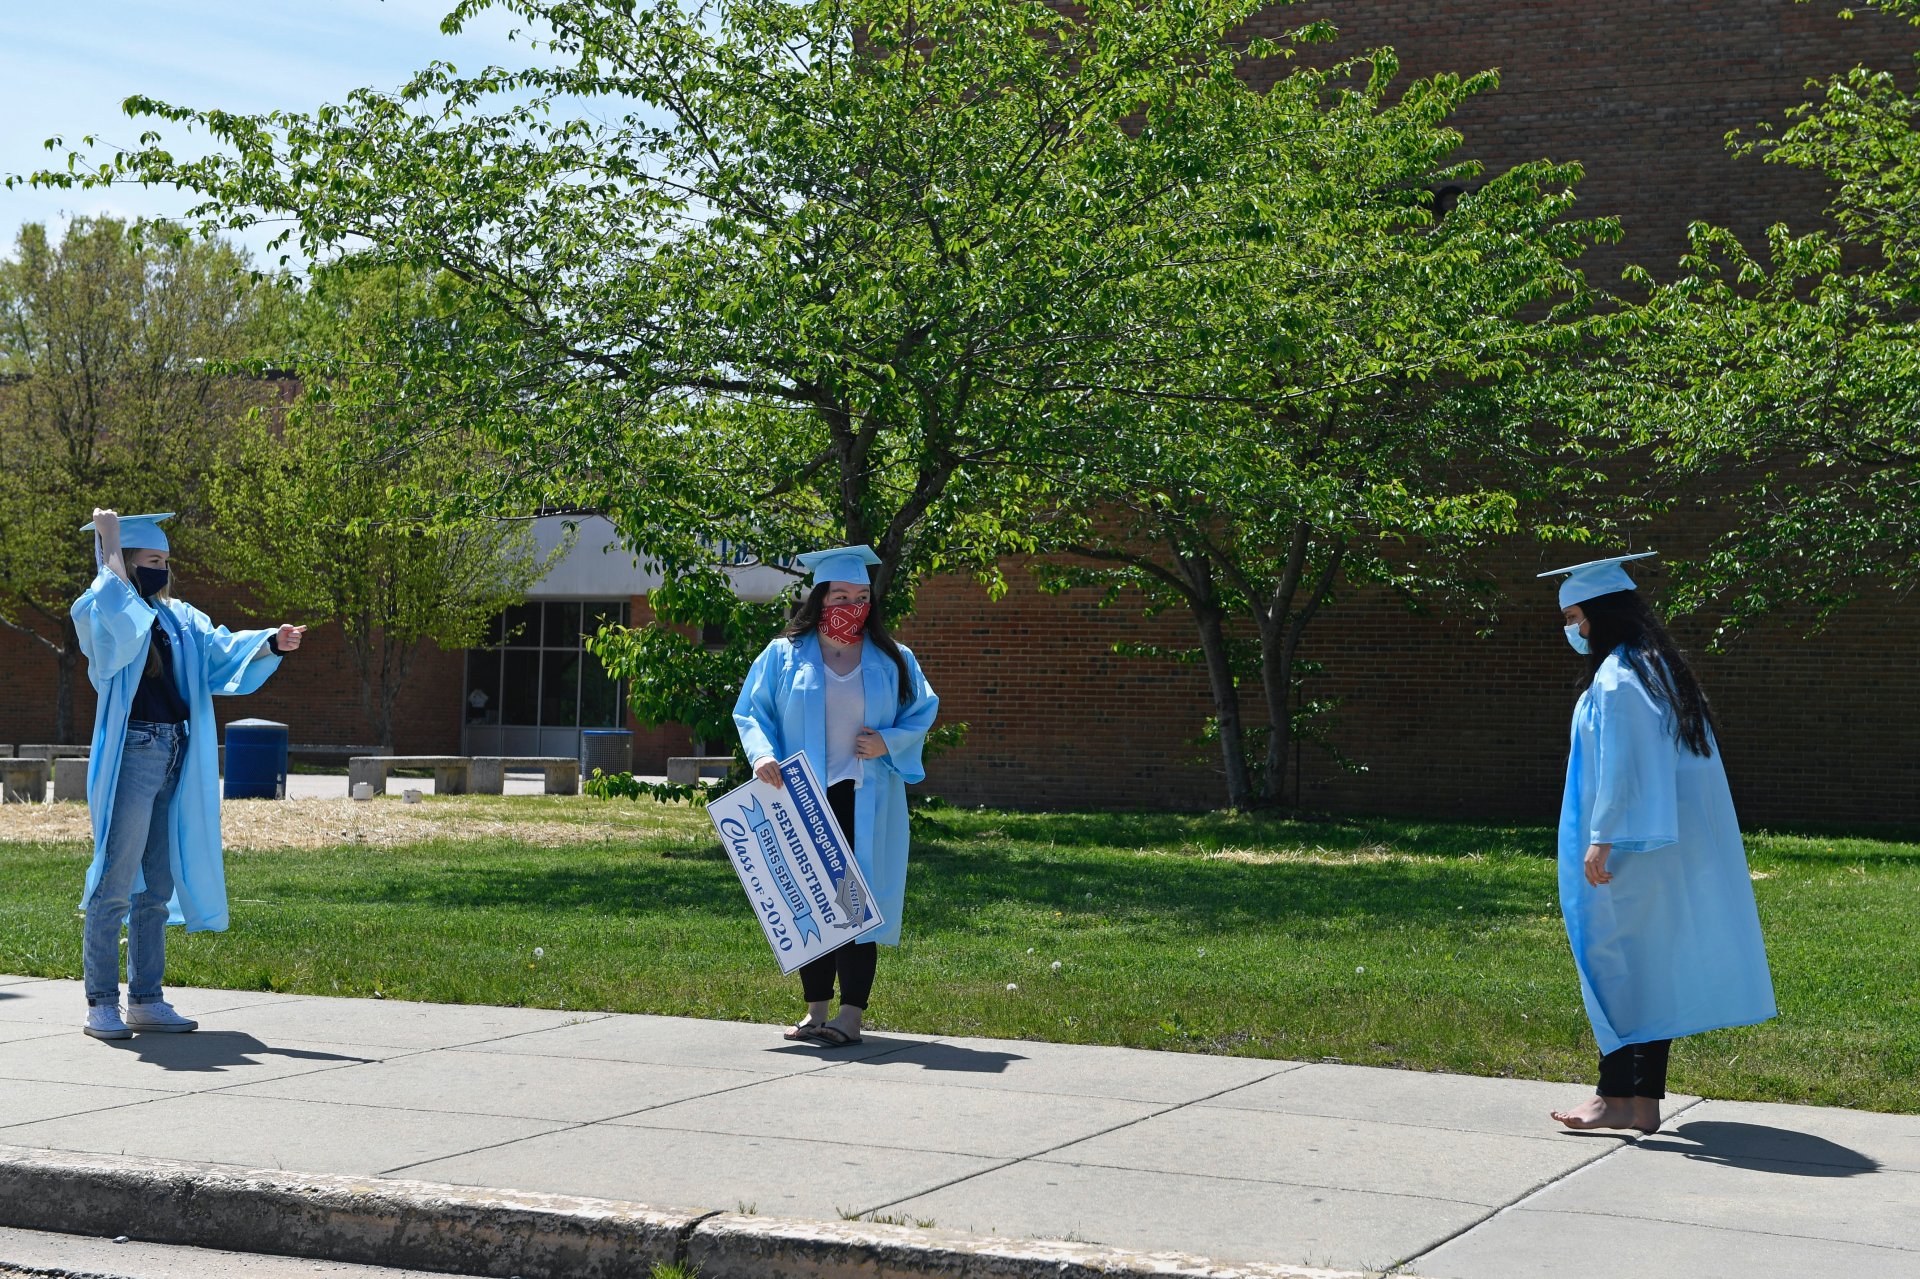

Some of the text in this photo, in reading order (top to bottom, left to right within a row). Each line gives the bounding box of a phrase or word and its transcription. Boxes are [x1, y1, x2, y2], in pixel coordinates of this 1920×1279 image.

[759, 828, 780, 865] SRHS
[774, 865, 805, 913] SENIOR
[771, 801, 836, 924] #SENIORSTRONG
[785, 766, 843, 872] #allinthistogether
[720, 817, 793, 951] Class OF 2020
[849, 880, 861, 916] SRHS
